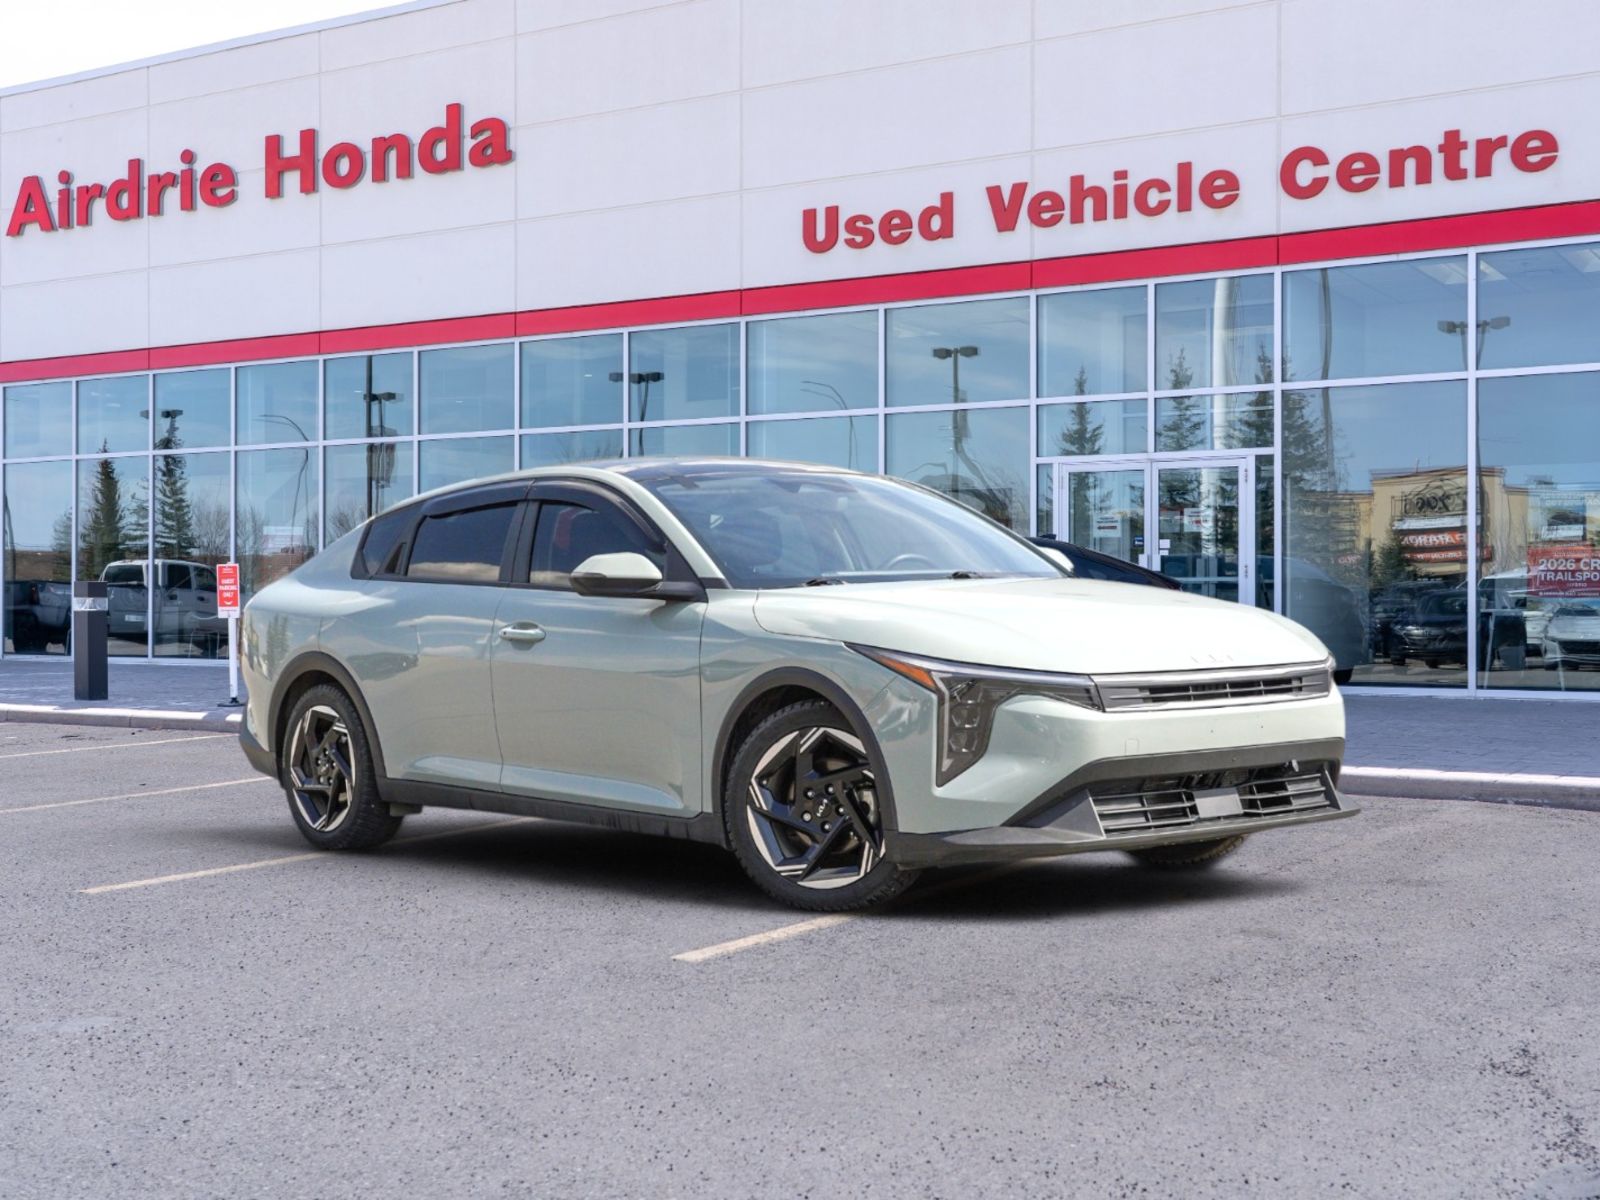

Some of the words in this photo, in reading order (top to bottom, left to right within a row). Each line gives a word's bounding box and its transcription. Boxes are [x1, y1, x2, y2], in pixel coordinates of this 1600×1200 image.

[7, 150, 237, 238] Airdrie
[265, 103, 514, 198] Honda
[803, 192, 954, 253] Used
[987, 162, 1240, 233] Vehicle
[1280, 130, 1559, 199] Centre
[1539, 558, 1576, 570] 2026
